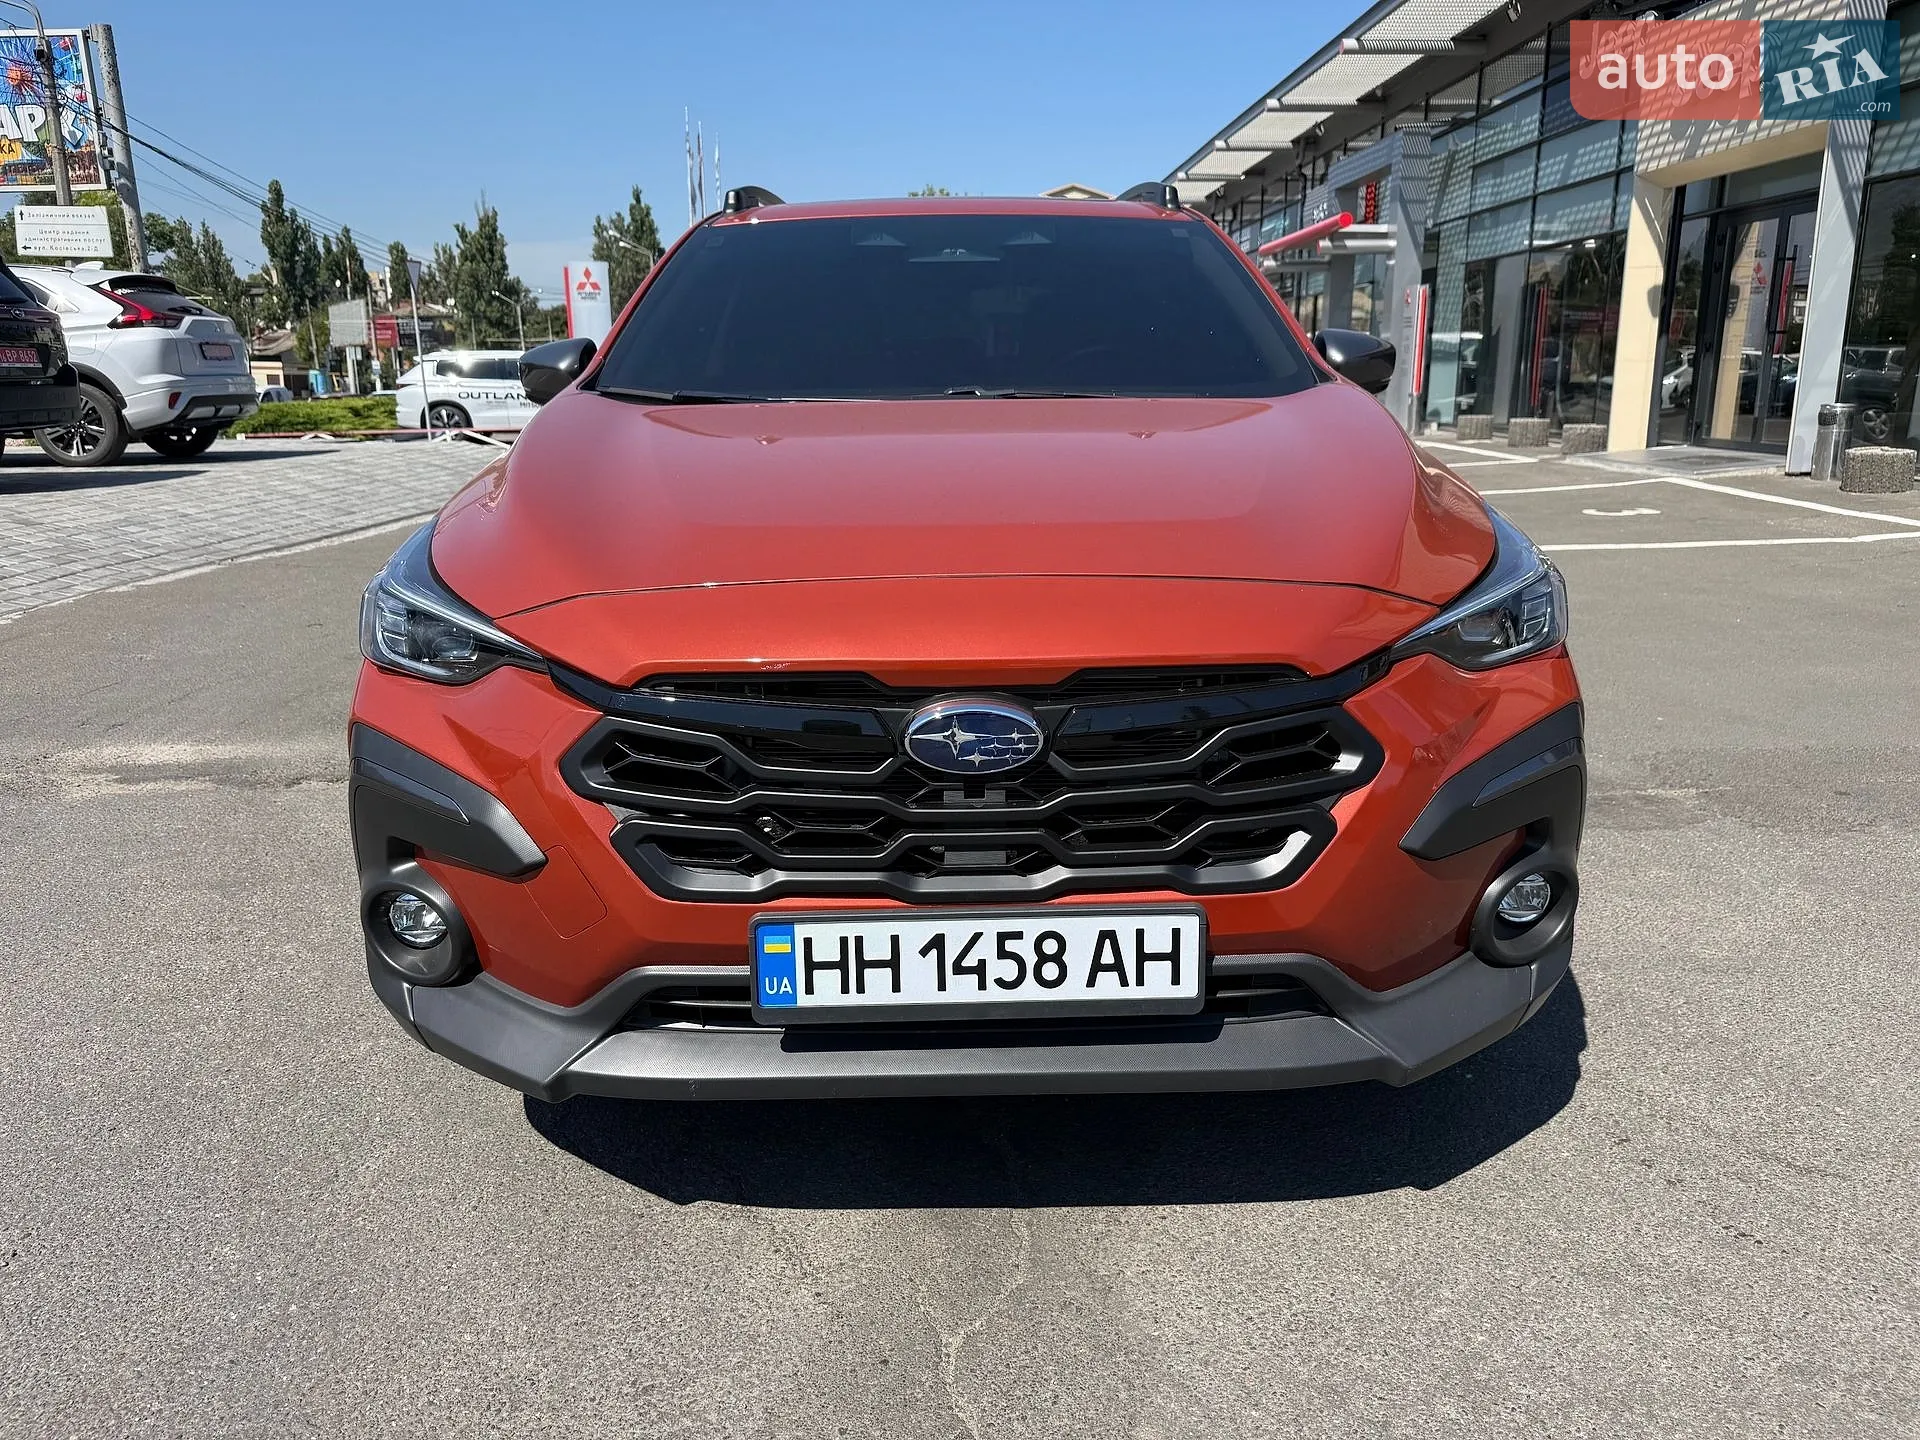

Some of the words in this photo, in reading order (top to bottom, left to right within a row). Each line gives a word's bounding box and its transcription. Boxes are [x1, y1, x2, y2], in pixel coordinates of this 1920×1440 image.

[802, 934, 901, 995] HH
[918, 930, 1068, 992] 1458
[1085, 927, 1181, 988] AH
[765, 976, 792, 995] UA
